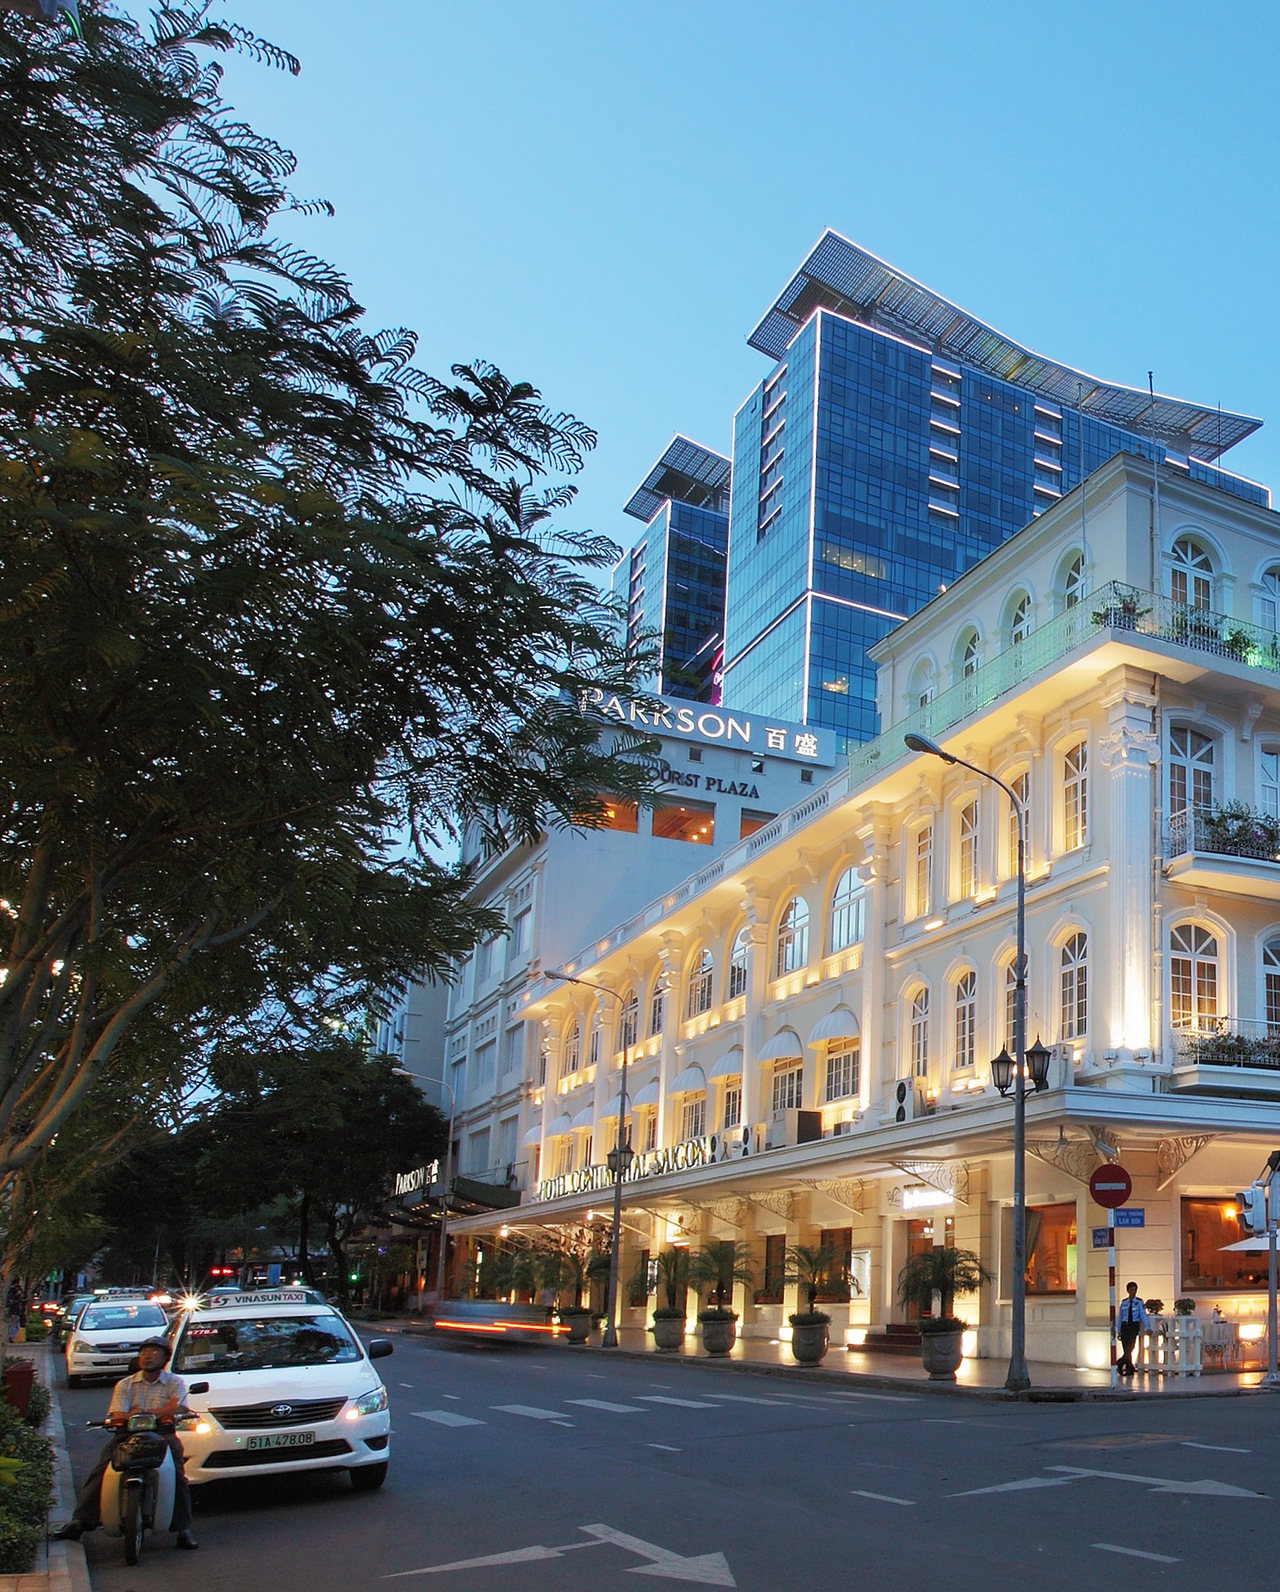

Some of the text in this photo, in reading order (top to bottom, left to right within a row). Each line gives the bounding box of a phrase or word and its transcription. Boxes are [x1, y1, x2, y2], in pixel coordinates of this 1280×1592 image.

[580, 686, 751, 743] PARKSON
[764, 727, 819, 758] 百盛
[641, 764, 761, 799] OURIST PLAZA
[539, 1136, 710, 1201] HOTEL CONTINTAL SAIGON
